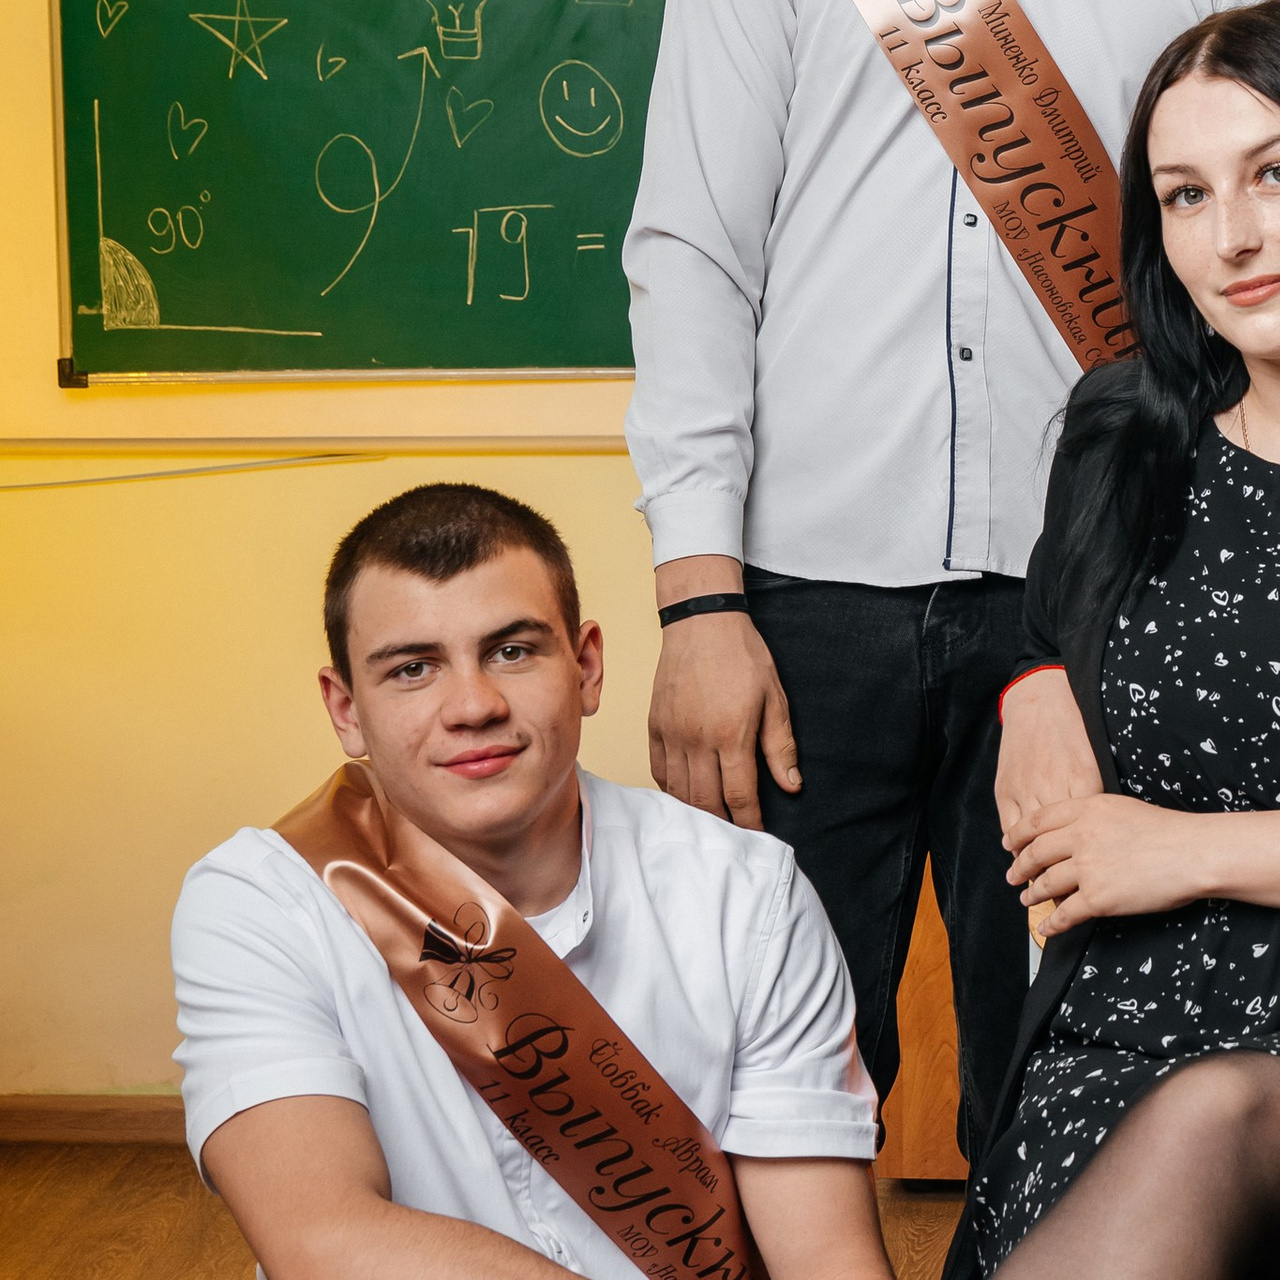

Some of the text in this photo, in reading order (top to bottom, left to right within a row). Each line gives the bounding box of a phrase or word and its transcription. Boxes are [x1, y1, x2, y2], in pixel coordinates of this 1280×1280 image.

[879, 25, 948, 125] 11 класс
[977, 0, 1103, 184] Миненко Дмитрий
[992, 199, 1031, 241] МОУ
[1016, 247, 1088, 346] «Насоновская
[477, 1078, 561, 1167] 11 класс
[651, 1135, 720, 1195] Аврам
[616, 1224, 659, 1260] МОУ
